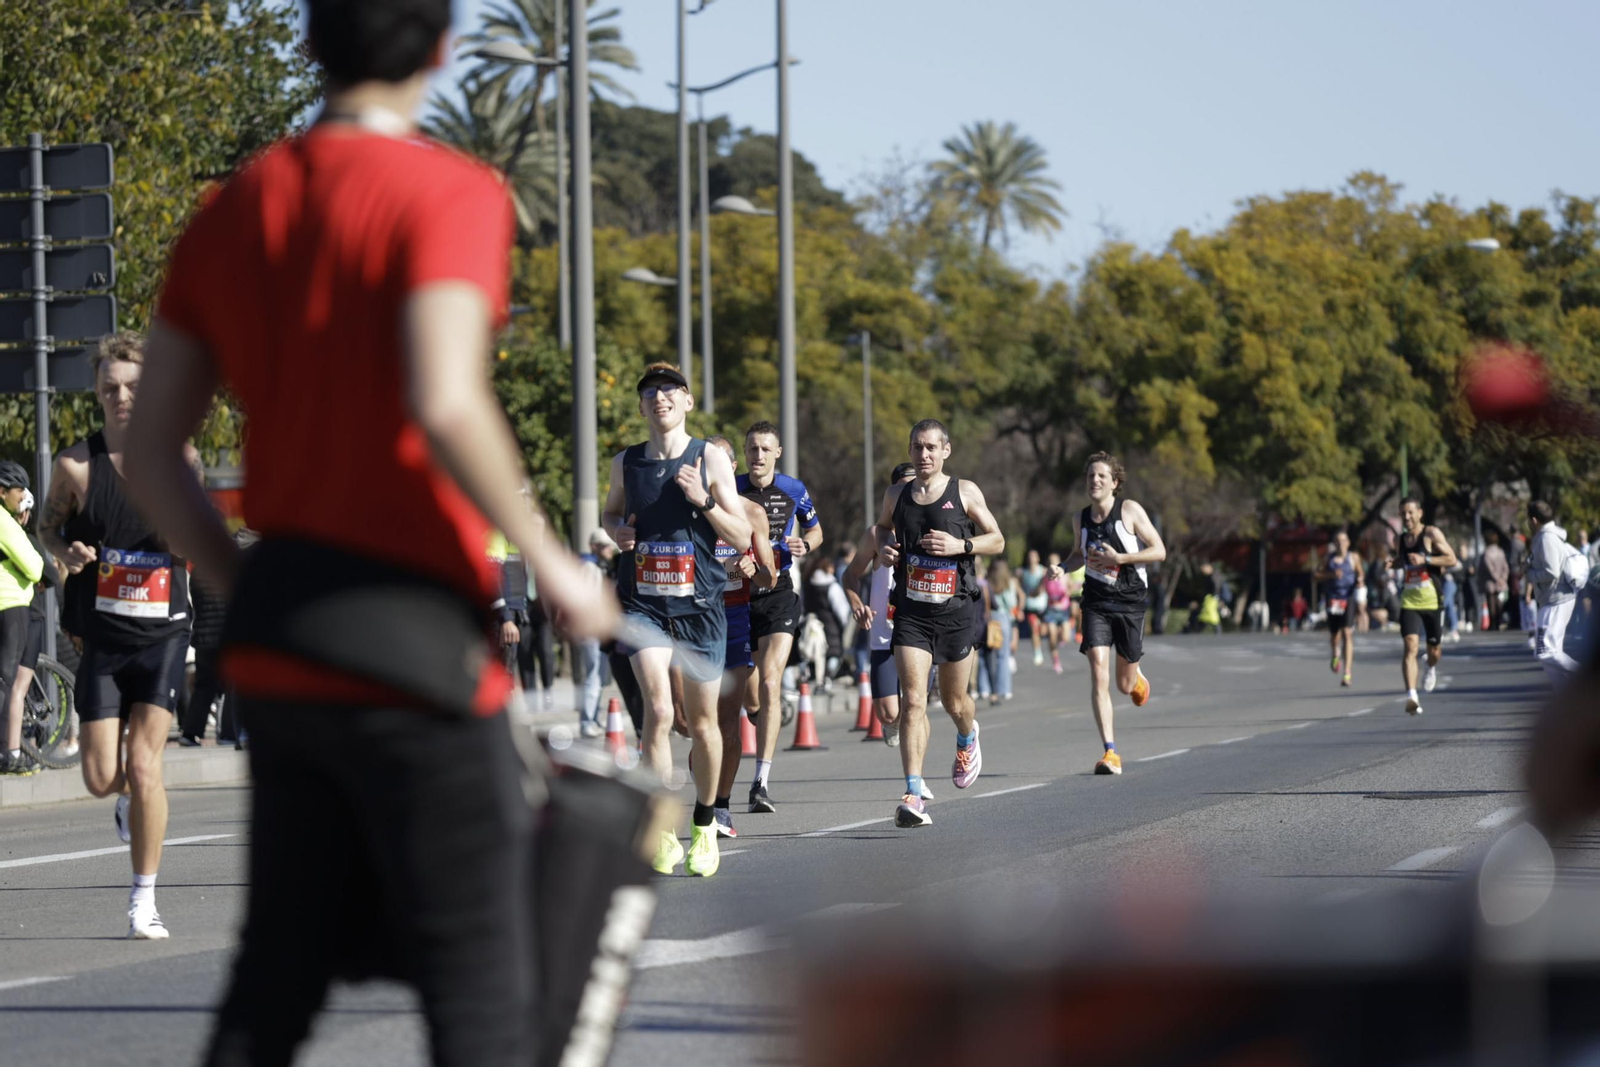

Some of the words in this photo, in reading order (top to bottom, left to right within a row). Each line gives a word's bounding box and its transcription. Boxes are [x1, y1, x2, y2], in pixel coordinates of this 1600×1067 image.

[652, 545, 687, 553] ZURICH
[124, 554, 164, 565] ZURICH
[656, 561, 670, 569] 833
[126, 573, 143, 583] 611
[642, 570, 686, 583] BIDMON
[909, 579, 952, 593] FREDERIC
[118, 585, 150, 601] ERIK
